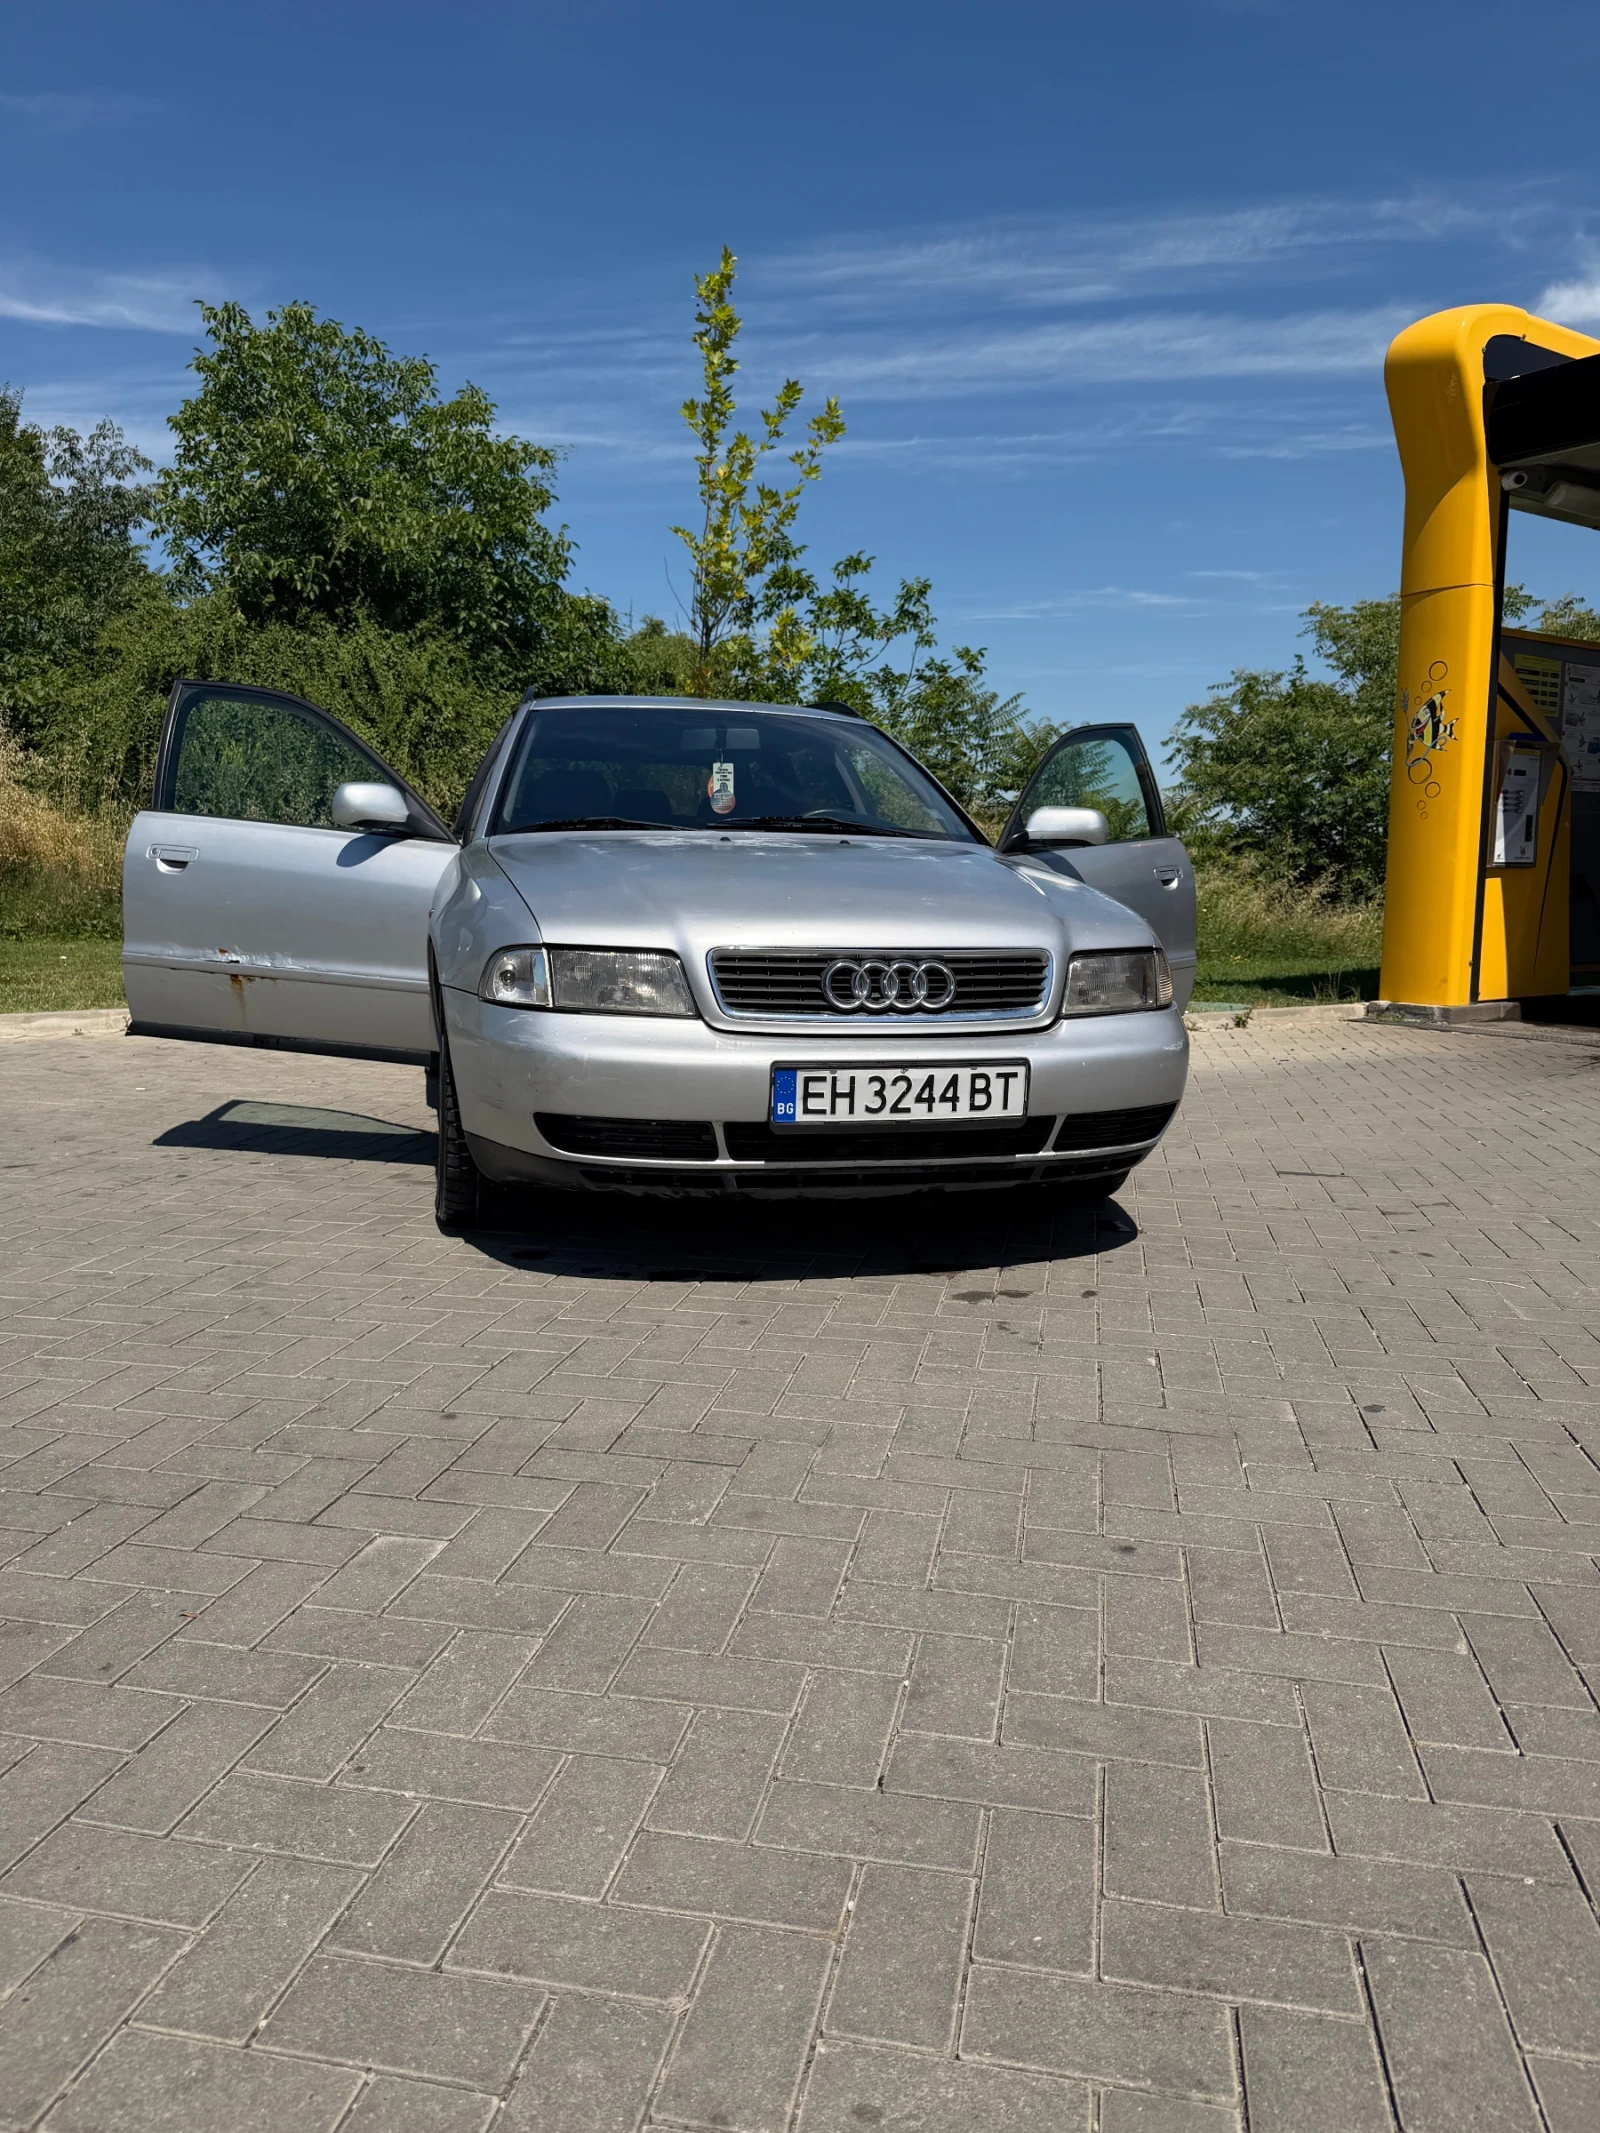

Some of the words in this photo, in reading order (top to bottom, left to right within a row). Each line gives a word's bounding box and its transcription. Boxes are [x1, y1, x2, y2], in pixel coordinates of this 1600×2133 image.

[802, 1075, 855, 1115] EH
[865, 1073, 959, 1114] 3244
[969, 1072, 1018, 1111] BT
[777, 1103, 794, 1115] BG
